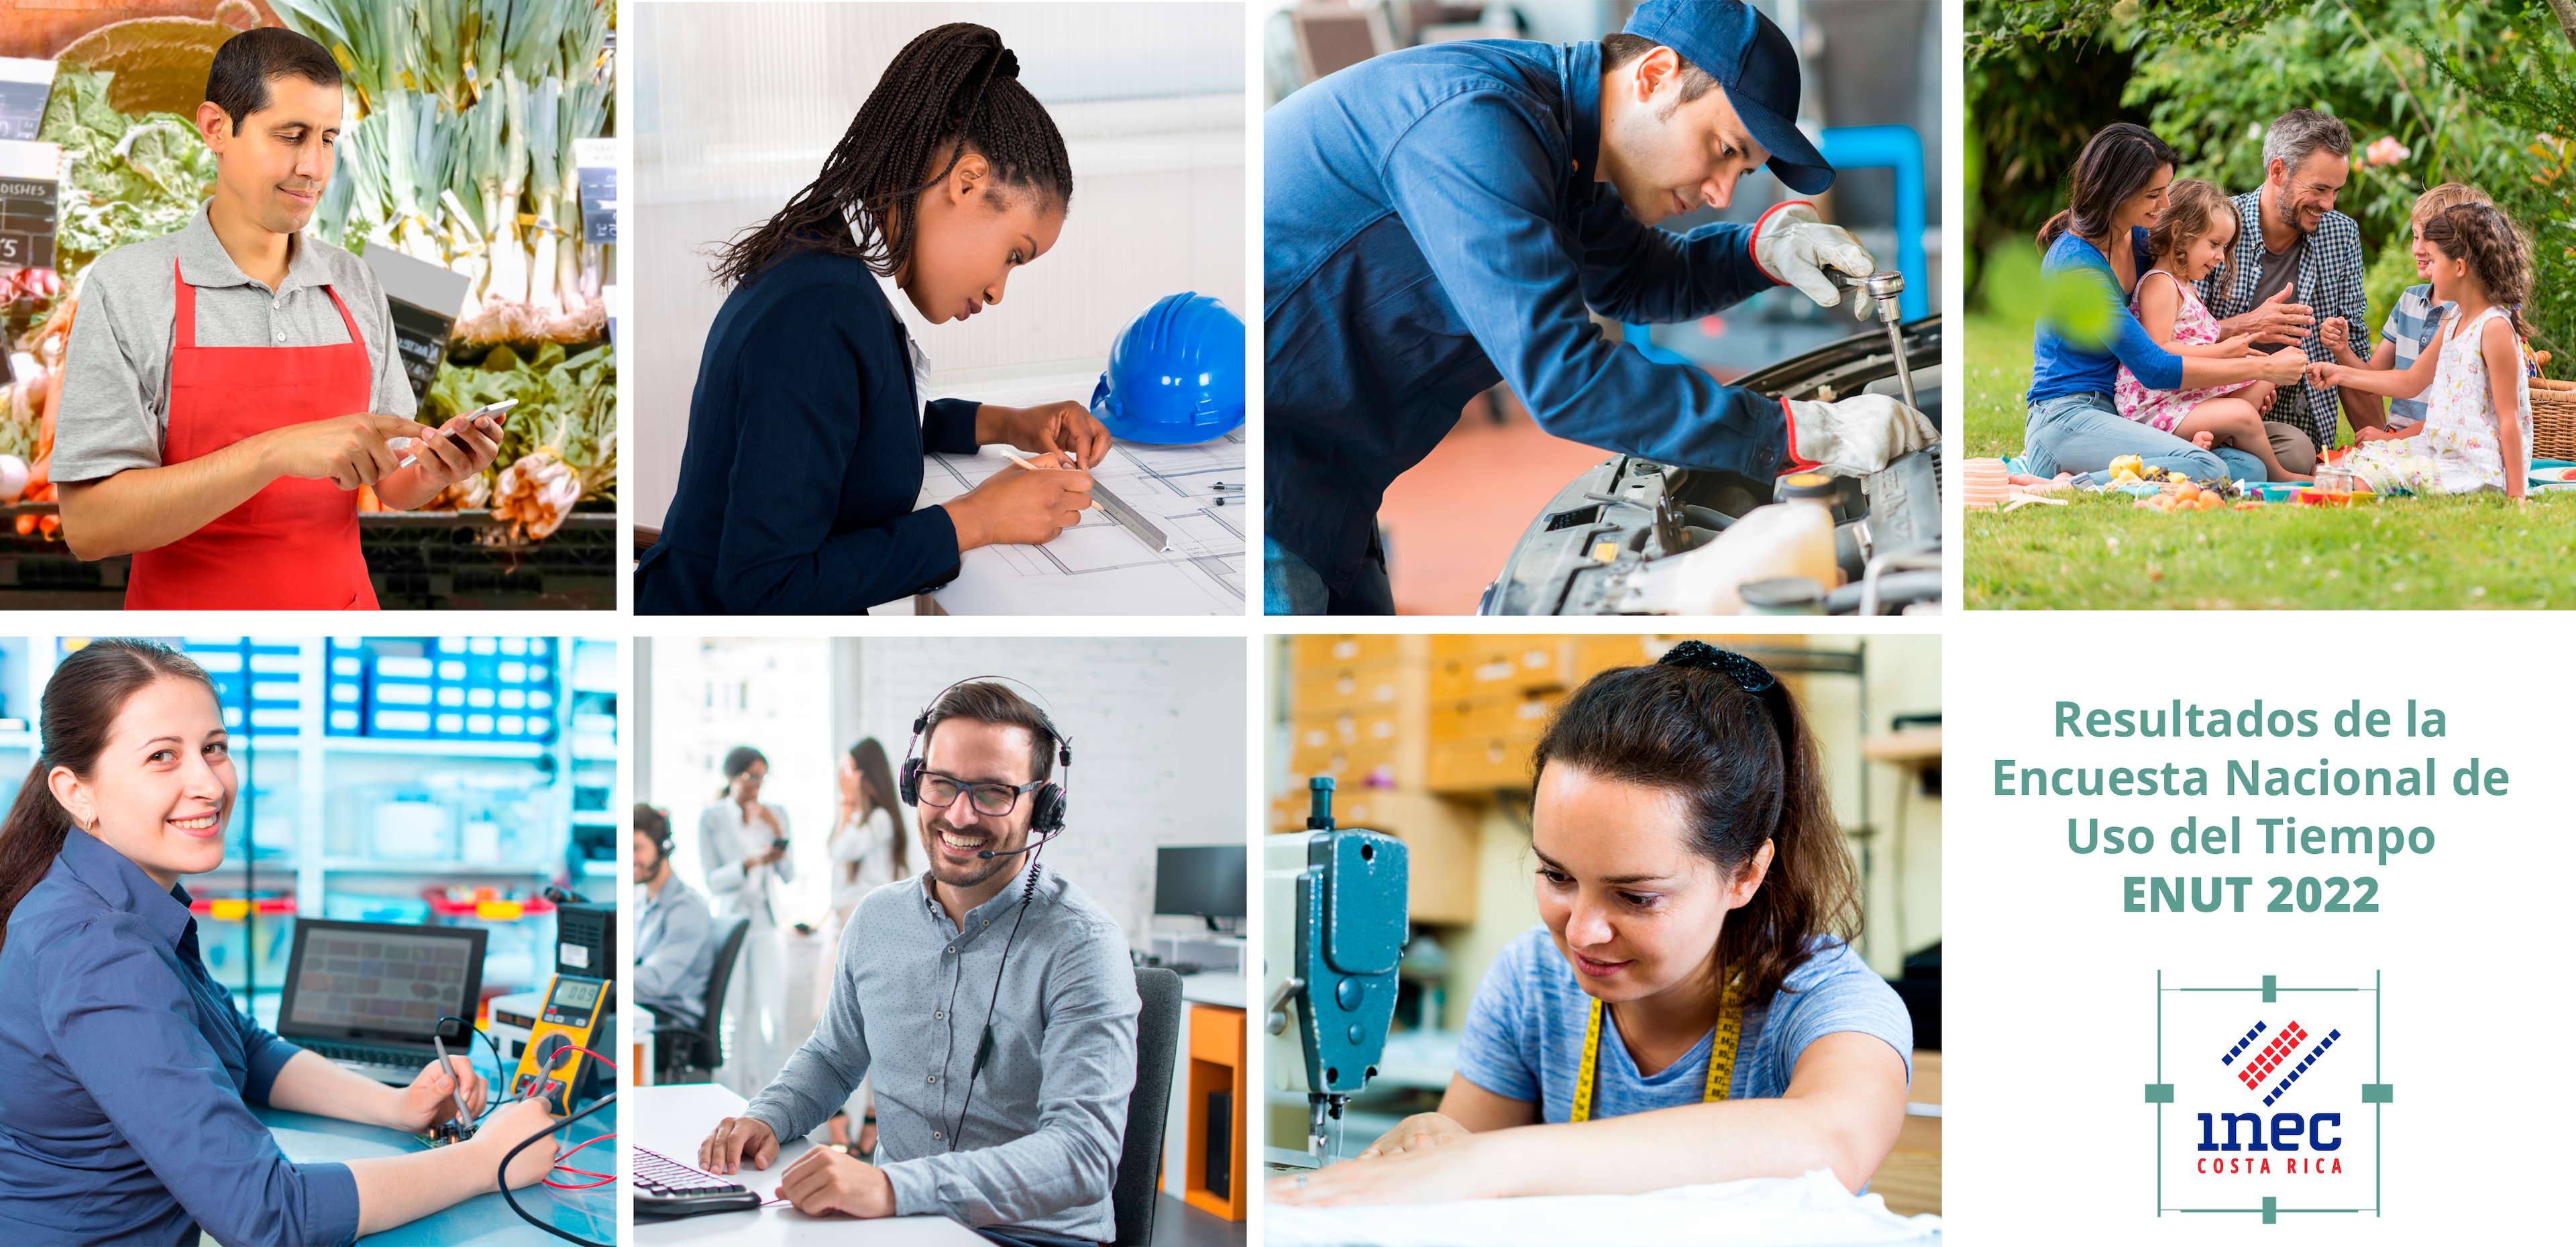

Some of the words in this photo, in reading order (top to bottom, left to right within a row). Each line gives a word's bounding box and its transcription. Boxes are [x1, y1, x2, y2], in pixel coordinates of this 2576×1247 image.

[1721, 1036, 1729, 1044] 84
[1718, 1049, 1727, 1058] 85
[1714, 1075, 1723, 1084] 87
